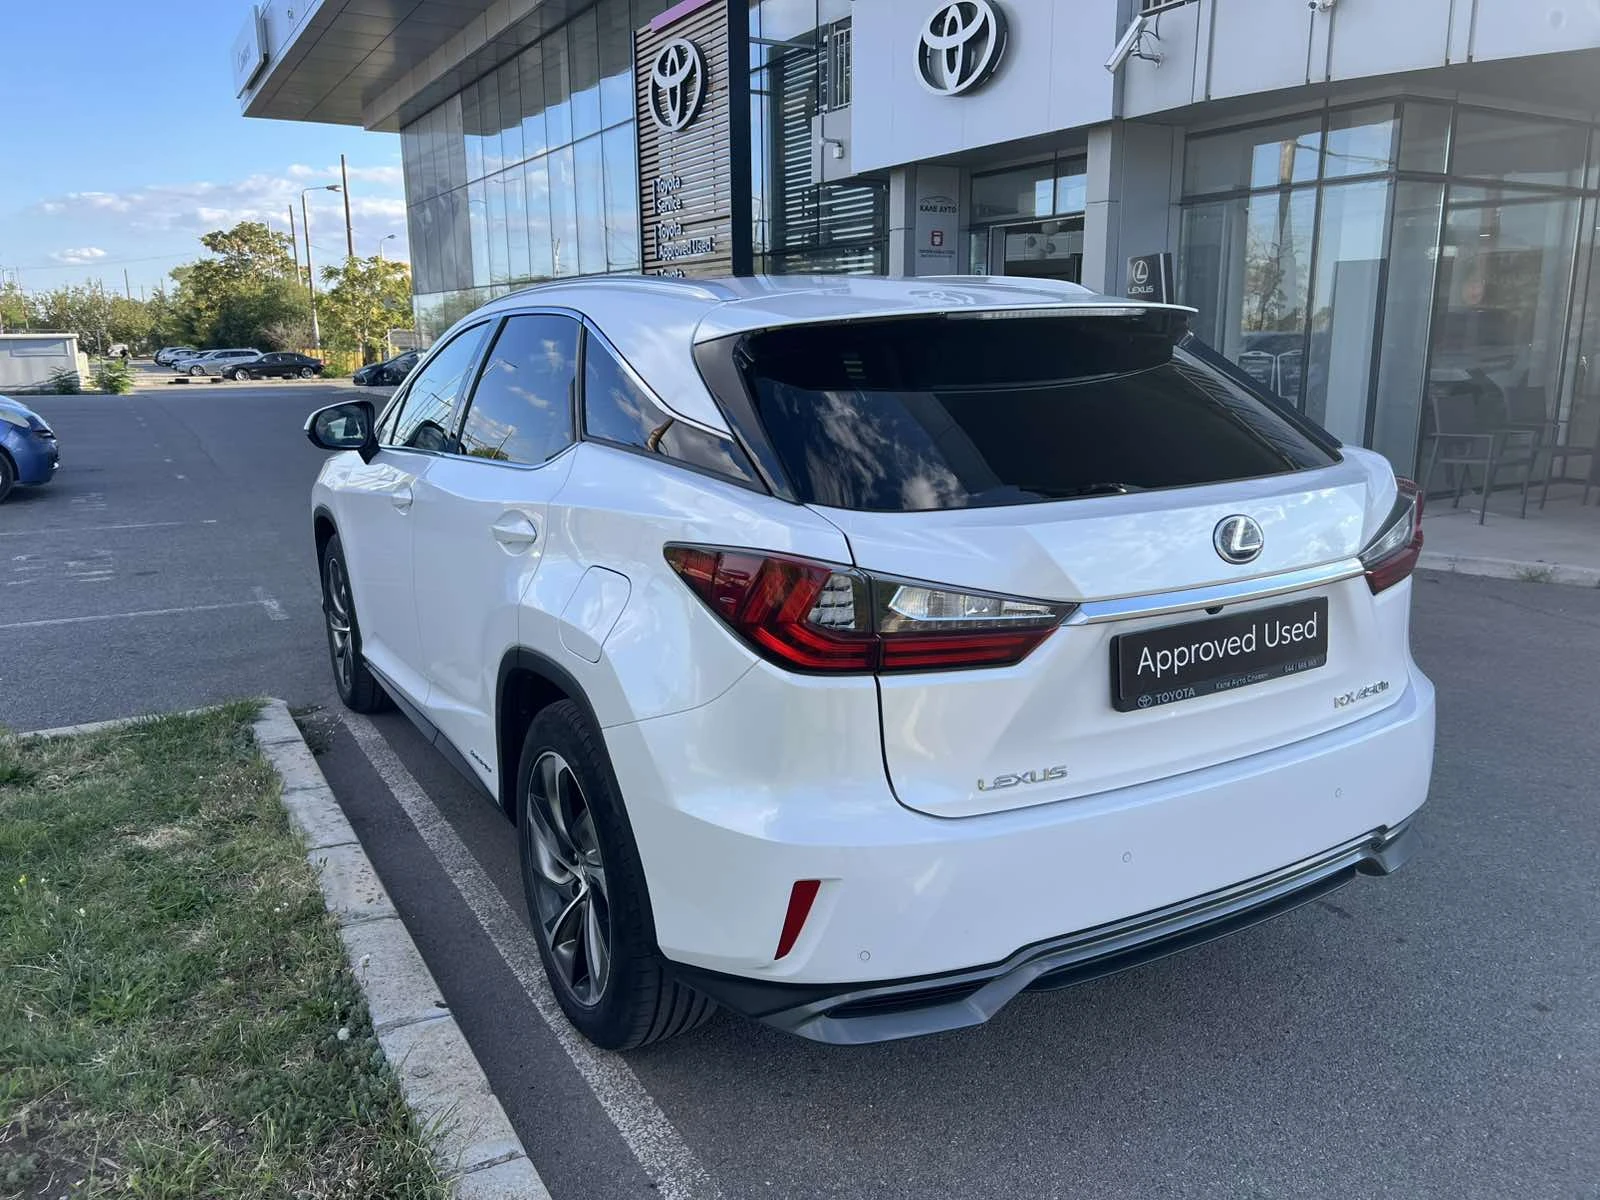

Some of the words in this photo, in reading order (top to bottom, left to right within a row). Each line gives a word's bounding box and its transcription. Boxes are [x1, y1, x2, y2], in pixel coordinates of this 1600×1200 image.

[657, 177, 681, 194] Toyota
[657, 199, 681, 213] Service
[658, 223, 681, 239] Toyota
[658, 242, 691, 259] Approved
[693, 238, 711, 254] Used
[1128, 286, 1153, 294] LEXUS
[1137, 624, 1256, 678] Approved
[1264, 611, 1317, 648] Used
[1155, 687, 1195, 704] TOYOTA
[977, 765, 1068, 791] LEXUS
